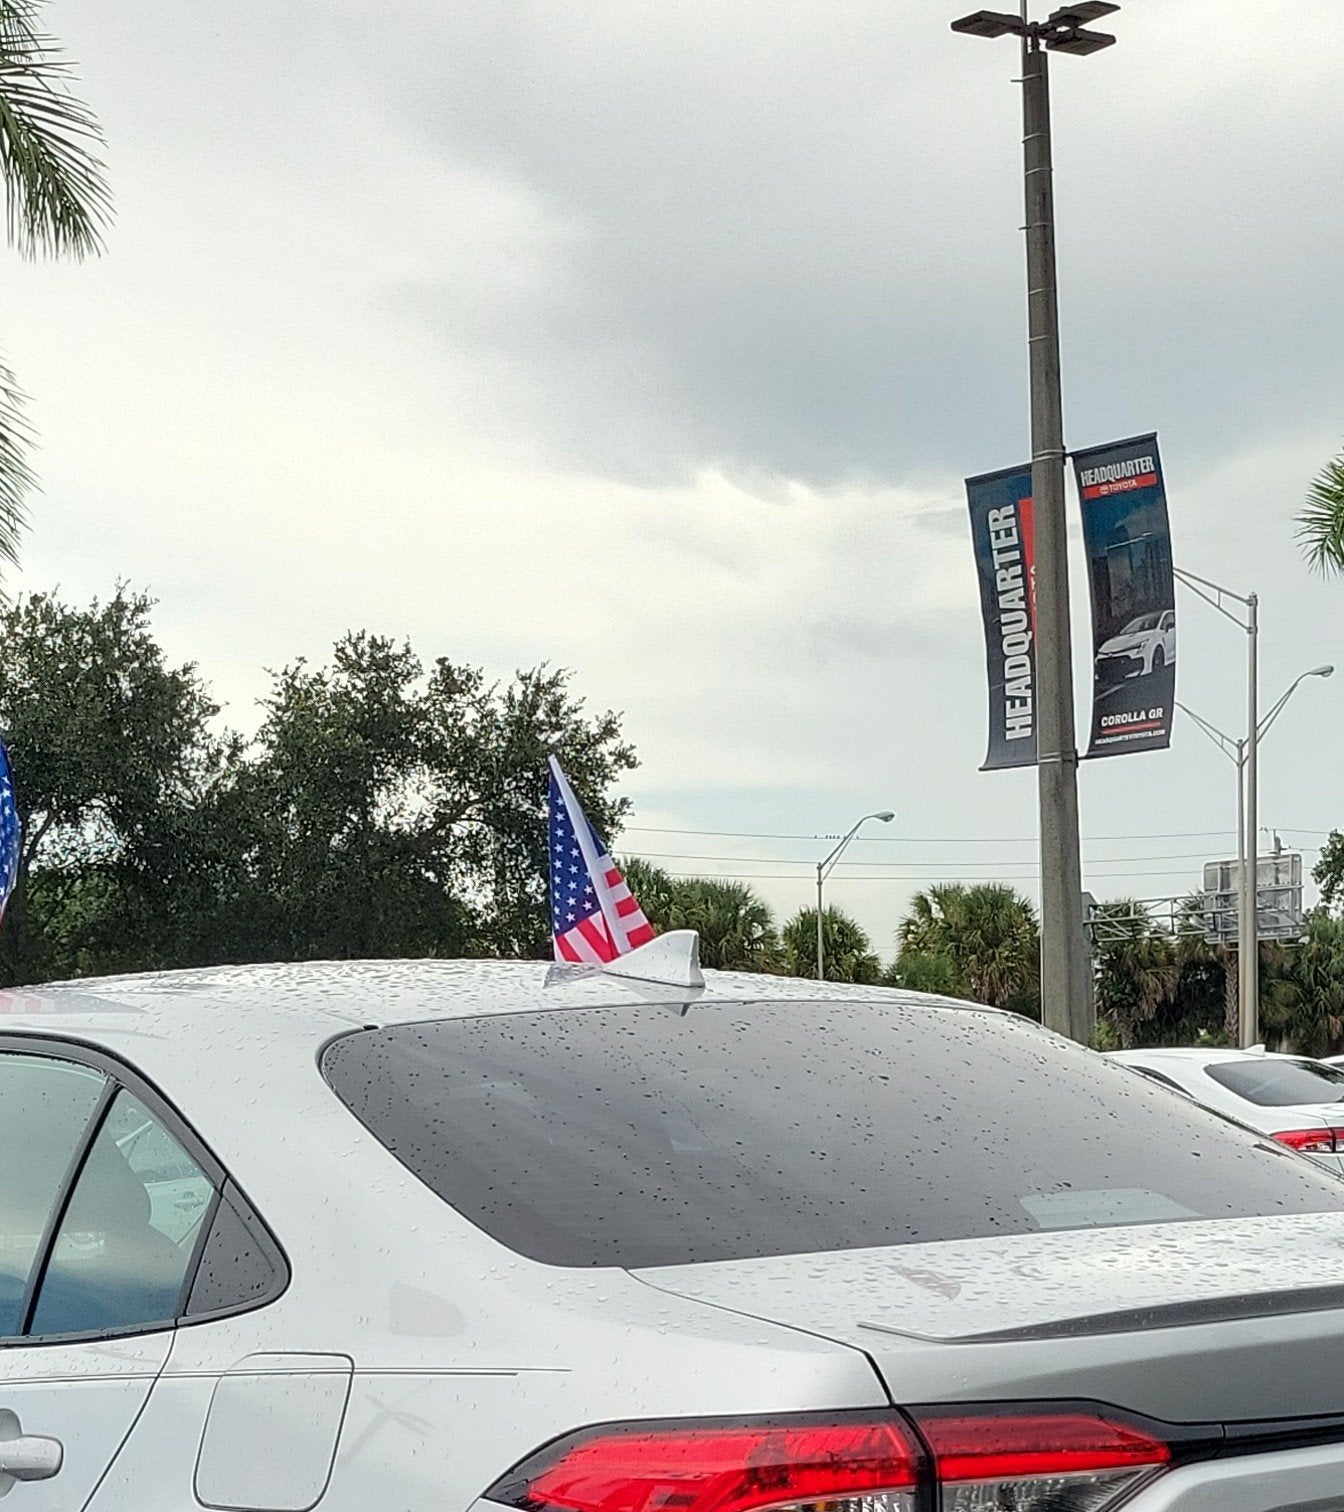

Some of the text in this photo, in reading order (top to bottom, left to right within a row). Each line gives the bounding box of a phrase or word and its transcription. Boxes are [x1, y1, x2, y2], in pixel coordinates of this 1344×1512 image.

[1080, 456, 1155, 487] HEADQUARTER
[1109, 479, 1137, 492] TOYOTA
[988, 504, 1033, 741] HEADQUARTER
[1101, 707, 1164, 727] COROLLA GR
